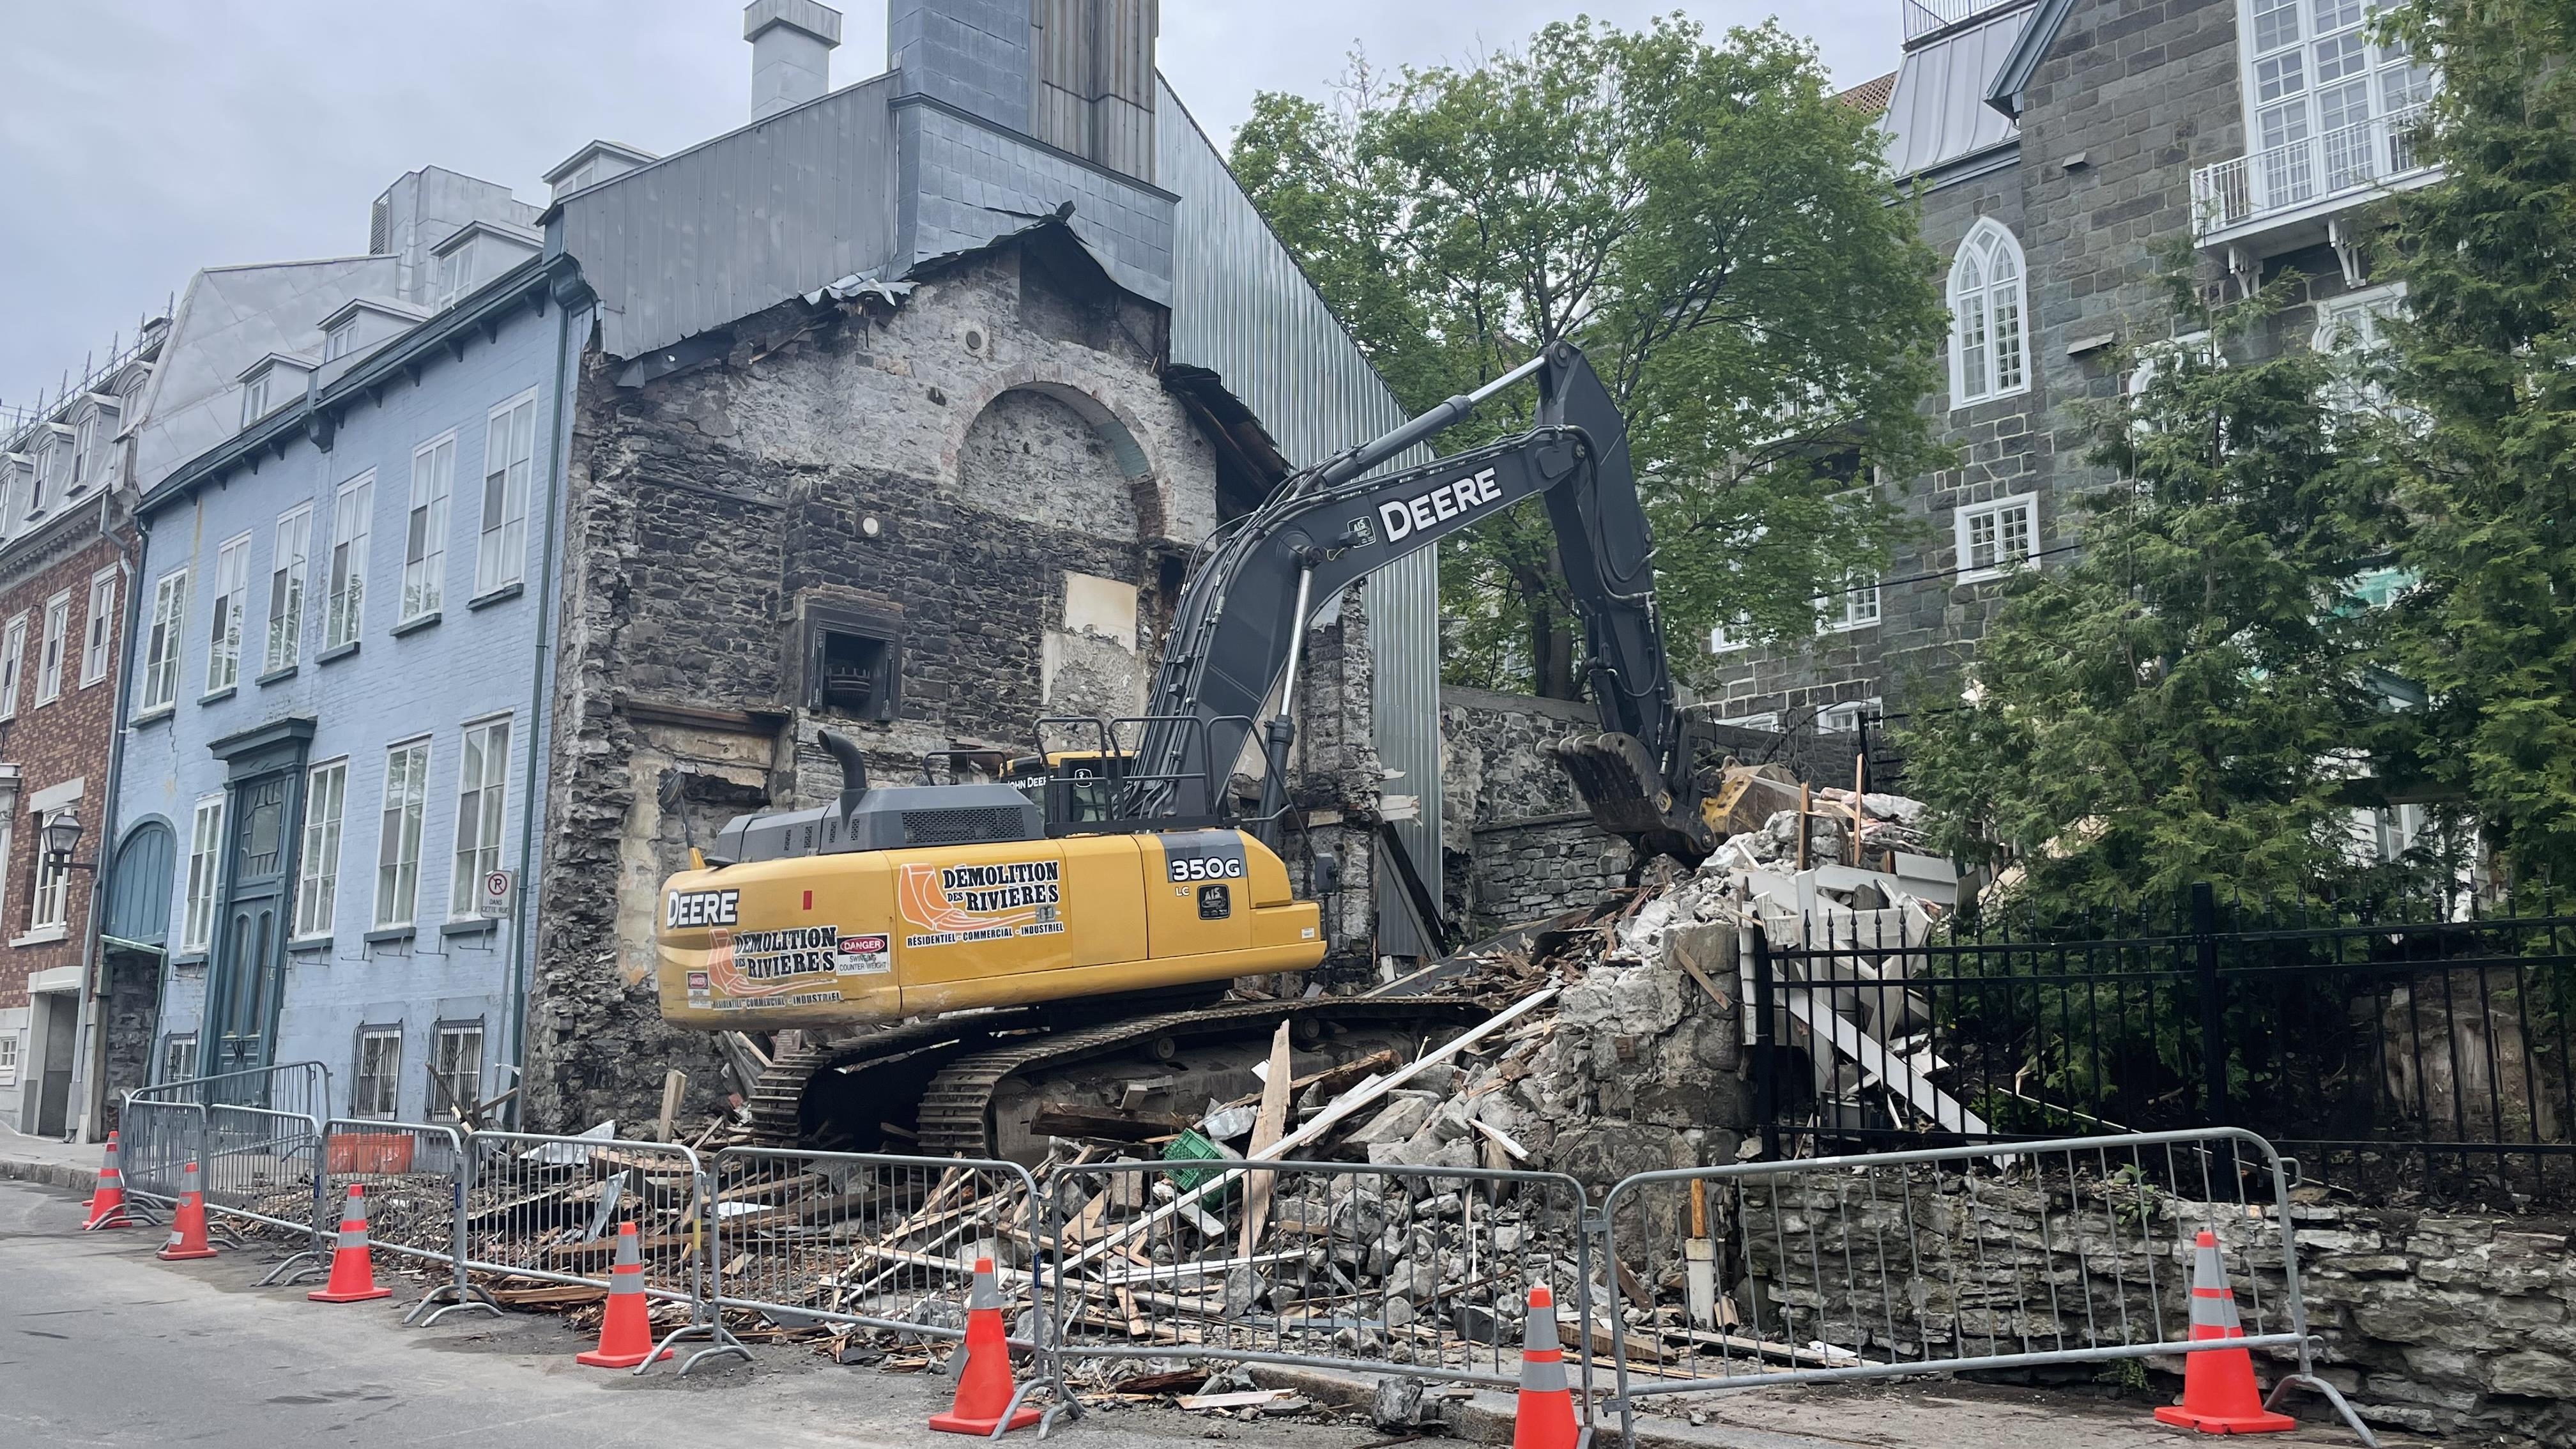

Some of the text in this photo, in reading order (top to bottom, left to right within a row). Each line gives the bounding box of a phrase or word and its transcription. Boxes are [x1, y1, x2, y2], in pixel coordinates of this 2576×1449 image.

[1379, 467, 1501, 542] DEERE
[942, 862, 1059, 889] DÉMOLITION
[1172, 857, 1241, 881] 350G
[947, 884, 1059, 912] DES RIVIÈRES
[1176, 886, 1190, 896] LC
[666, 891, 739, 926] DEERE
[844, 940, 881, 950] DANGER
[907, 923, 1063, 947] RÉSIDENTIEL COMMERCIAL INDUSTRIEL
[735, 951, 835, 979] DES RIVIÈRES
[793, 992, 840, 1004] INDUSTRIEL
